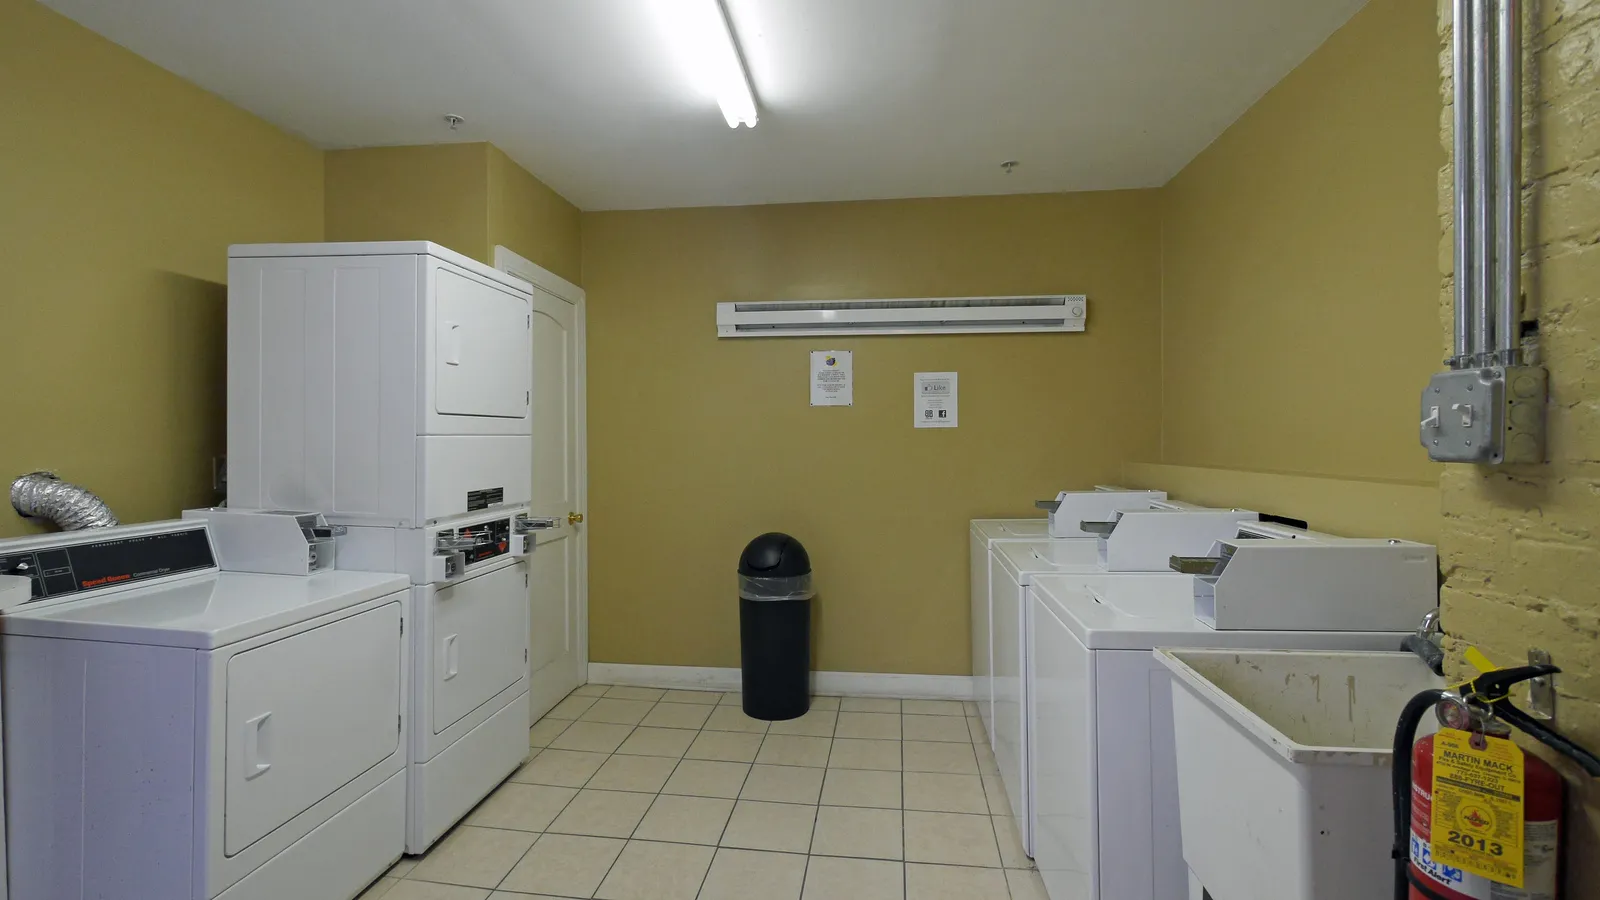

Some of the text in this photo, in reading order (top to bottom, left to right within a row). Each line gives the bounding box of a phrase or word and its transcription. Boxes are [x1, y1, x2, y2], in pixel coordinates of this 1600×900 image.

[82, 577, 107, 588] Speed
[107, 574, 131, 582] Queen
[1443, 750, 1480, 765] MARTIN
[1484, 759, 1513, 772] MACK
[1448, 830, 1503, 856] 2013
[1413, 856, 1427, 872] First
[1427, 869, 1452, 885] Alert
